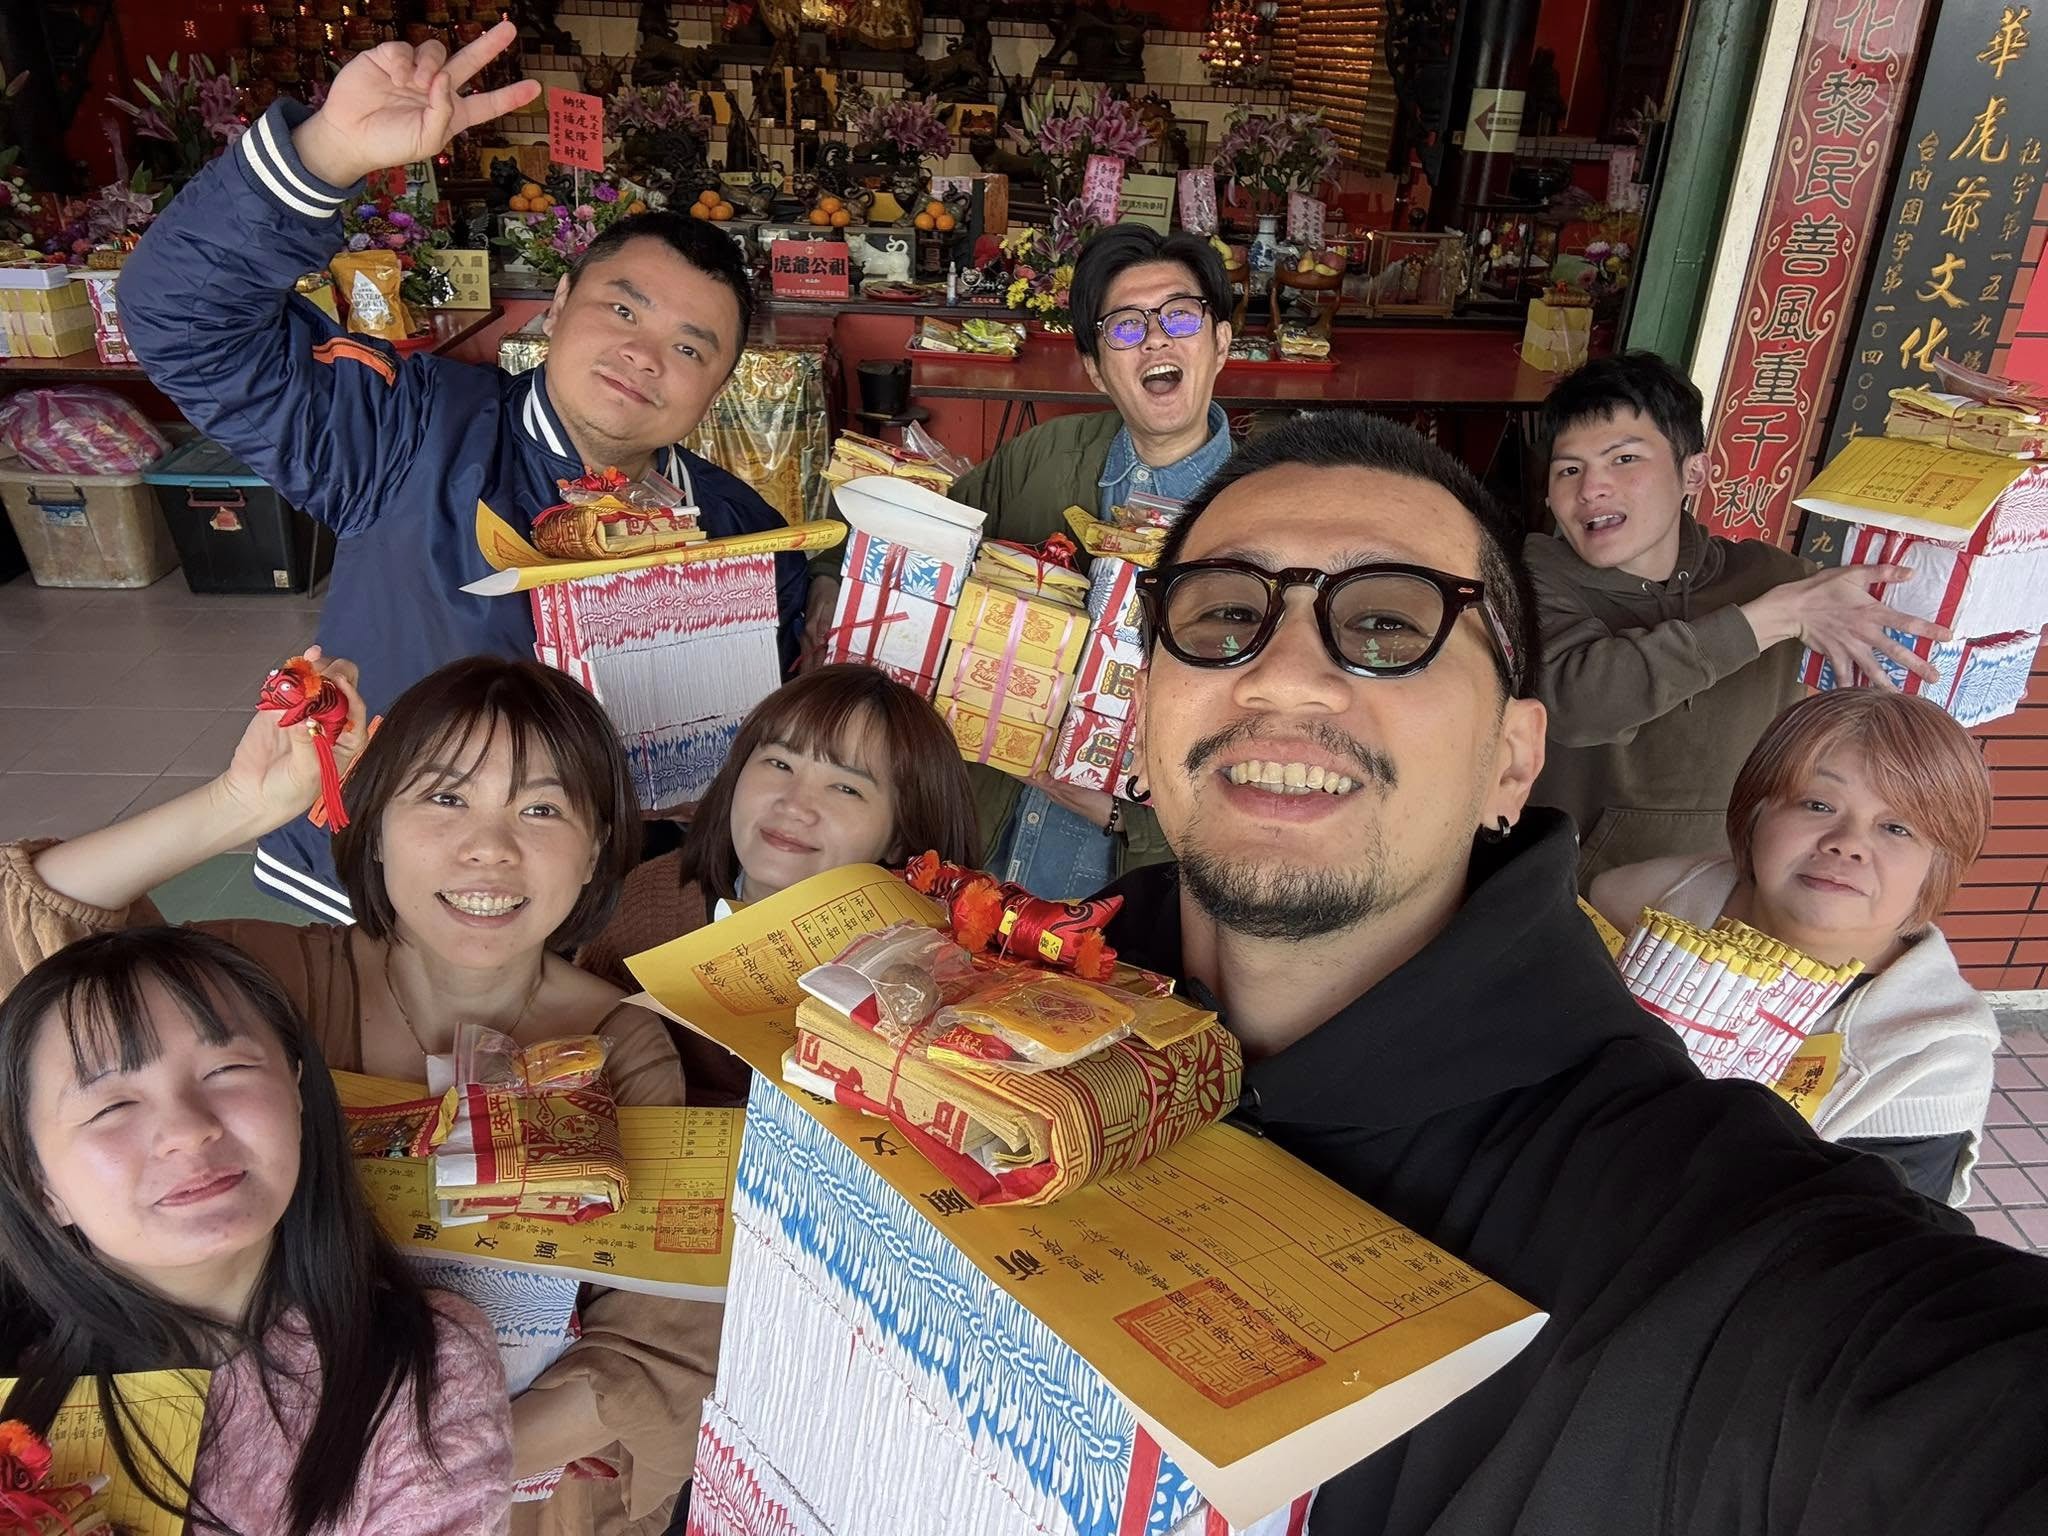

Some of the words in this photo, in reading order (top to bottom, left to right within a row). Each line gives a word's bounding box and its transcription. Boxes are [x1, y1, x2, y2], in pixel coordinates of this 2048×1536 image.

[1900, 7, 2031, 392] 華虎爺文化
